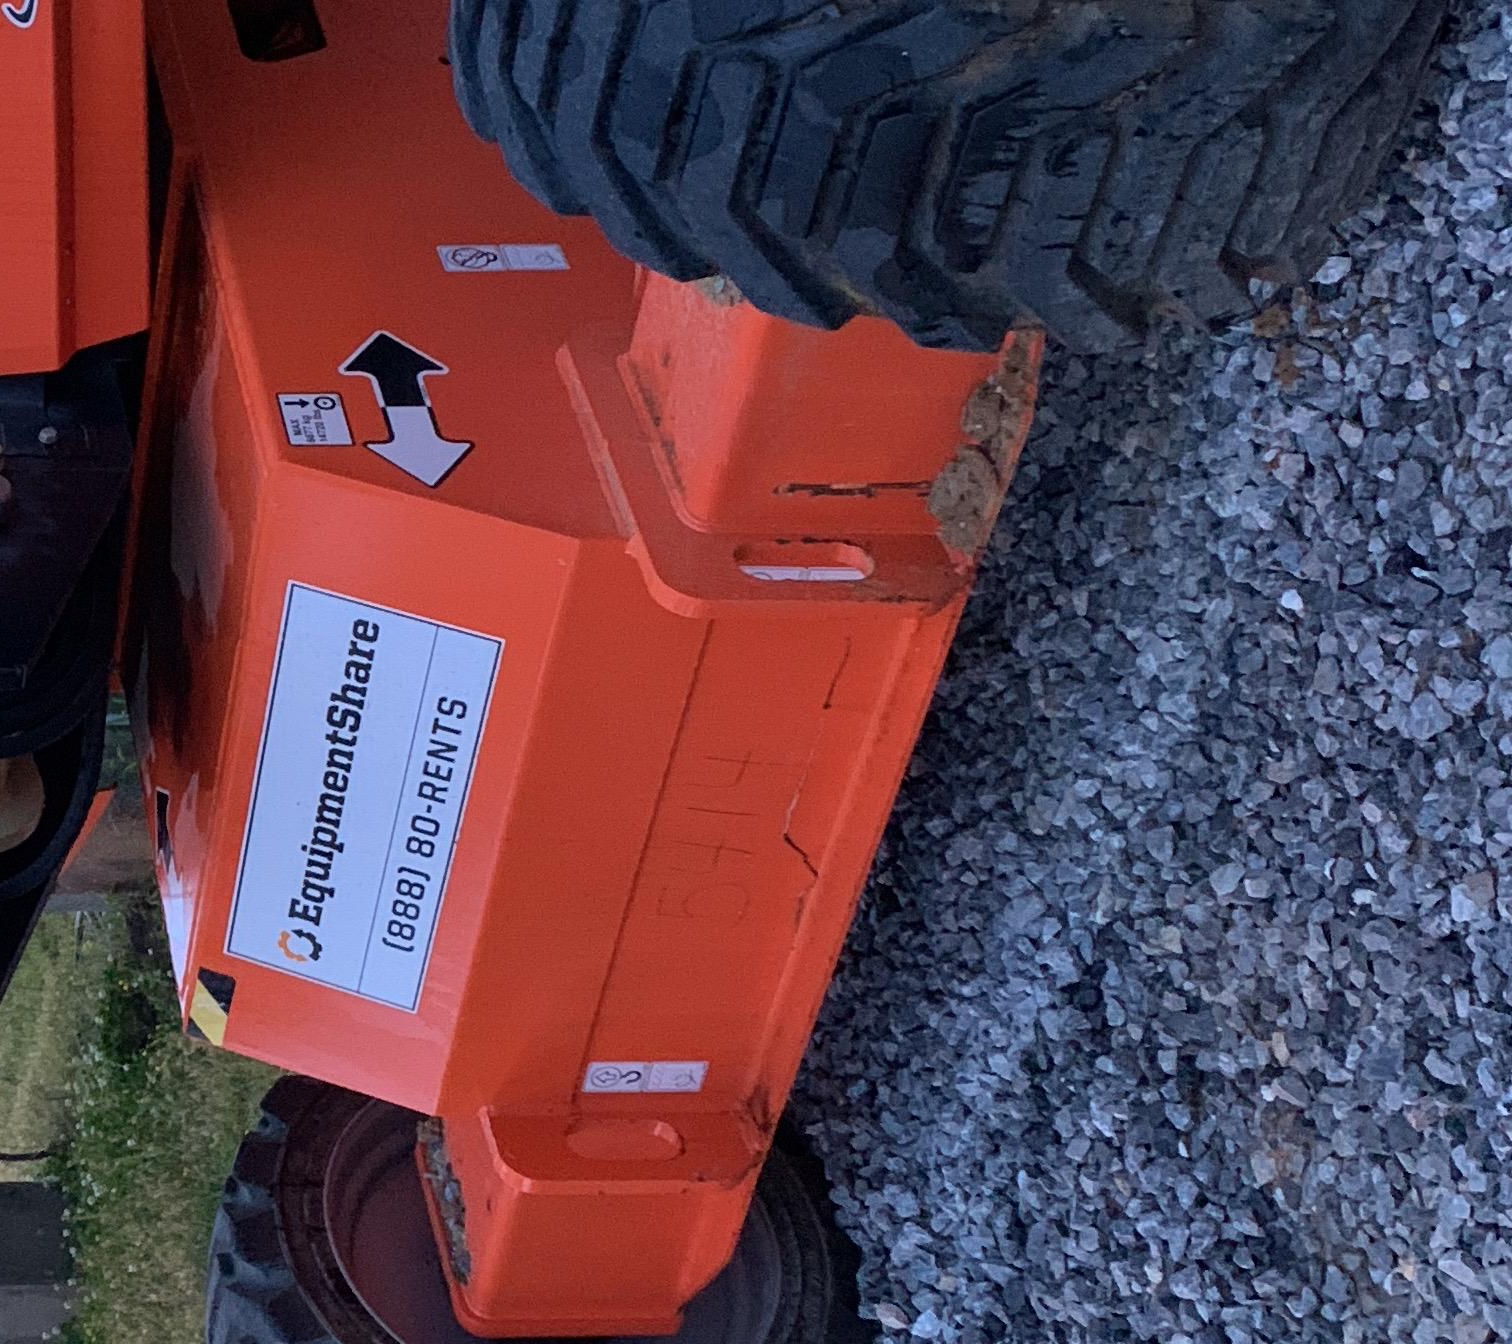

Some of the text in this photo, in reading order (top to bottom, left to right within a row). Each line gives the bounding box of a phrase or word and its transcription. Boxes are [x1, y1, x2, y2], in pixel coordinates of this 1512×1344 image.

[290, 419, 303, 436] MAX
[289, 617, 380, 928] EquipmentShare
[382, 695, 468, 953] (888) 80-RENTS
